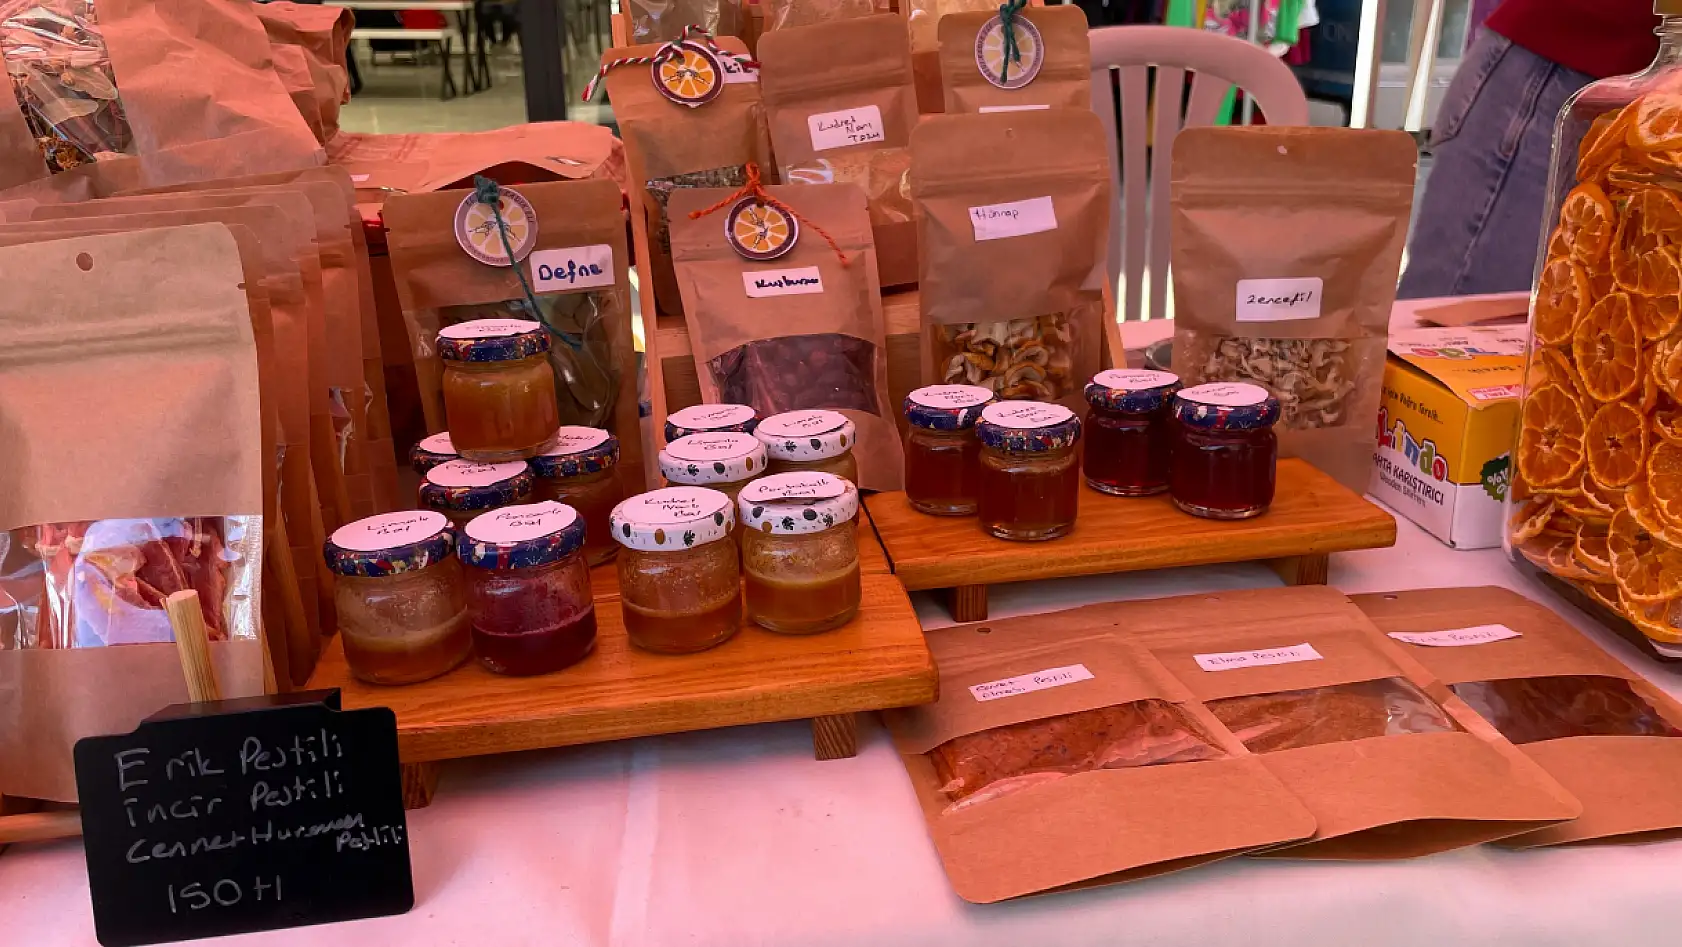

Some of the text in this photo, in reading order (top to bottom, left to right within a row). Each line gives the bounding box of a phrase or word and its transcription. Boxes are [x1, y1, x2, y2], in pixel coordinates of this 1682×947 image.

[1372, 453, 1392, 475] AHTA
[1376, 406, 1448, 482] Lindo
[113, 727, 344, 792] Erik Pestili
[249, 769, 344, 812] Pestili
[168, 878, 241, 913] 150
